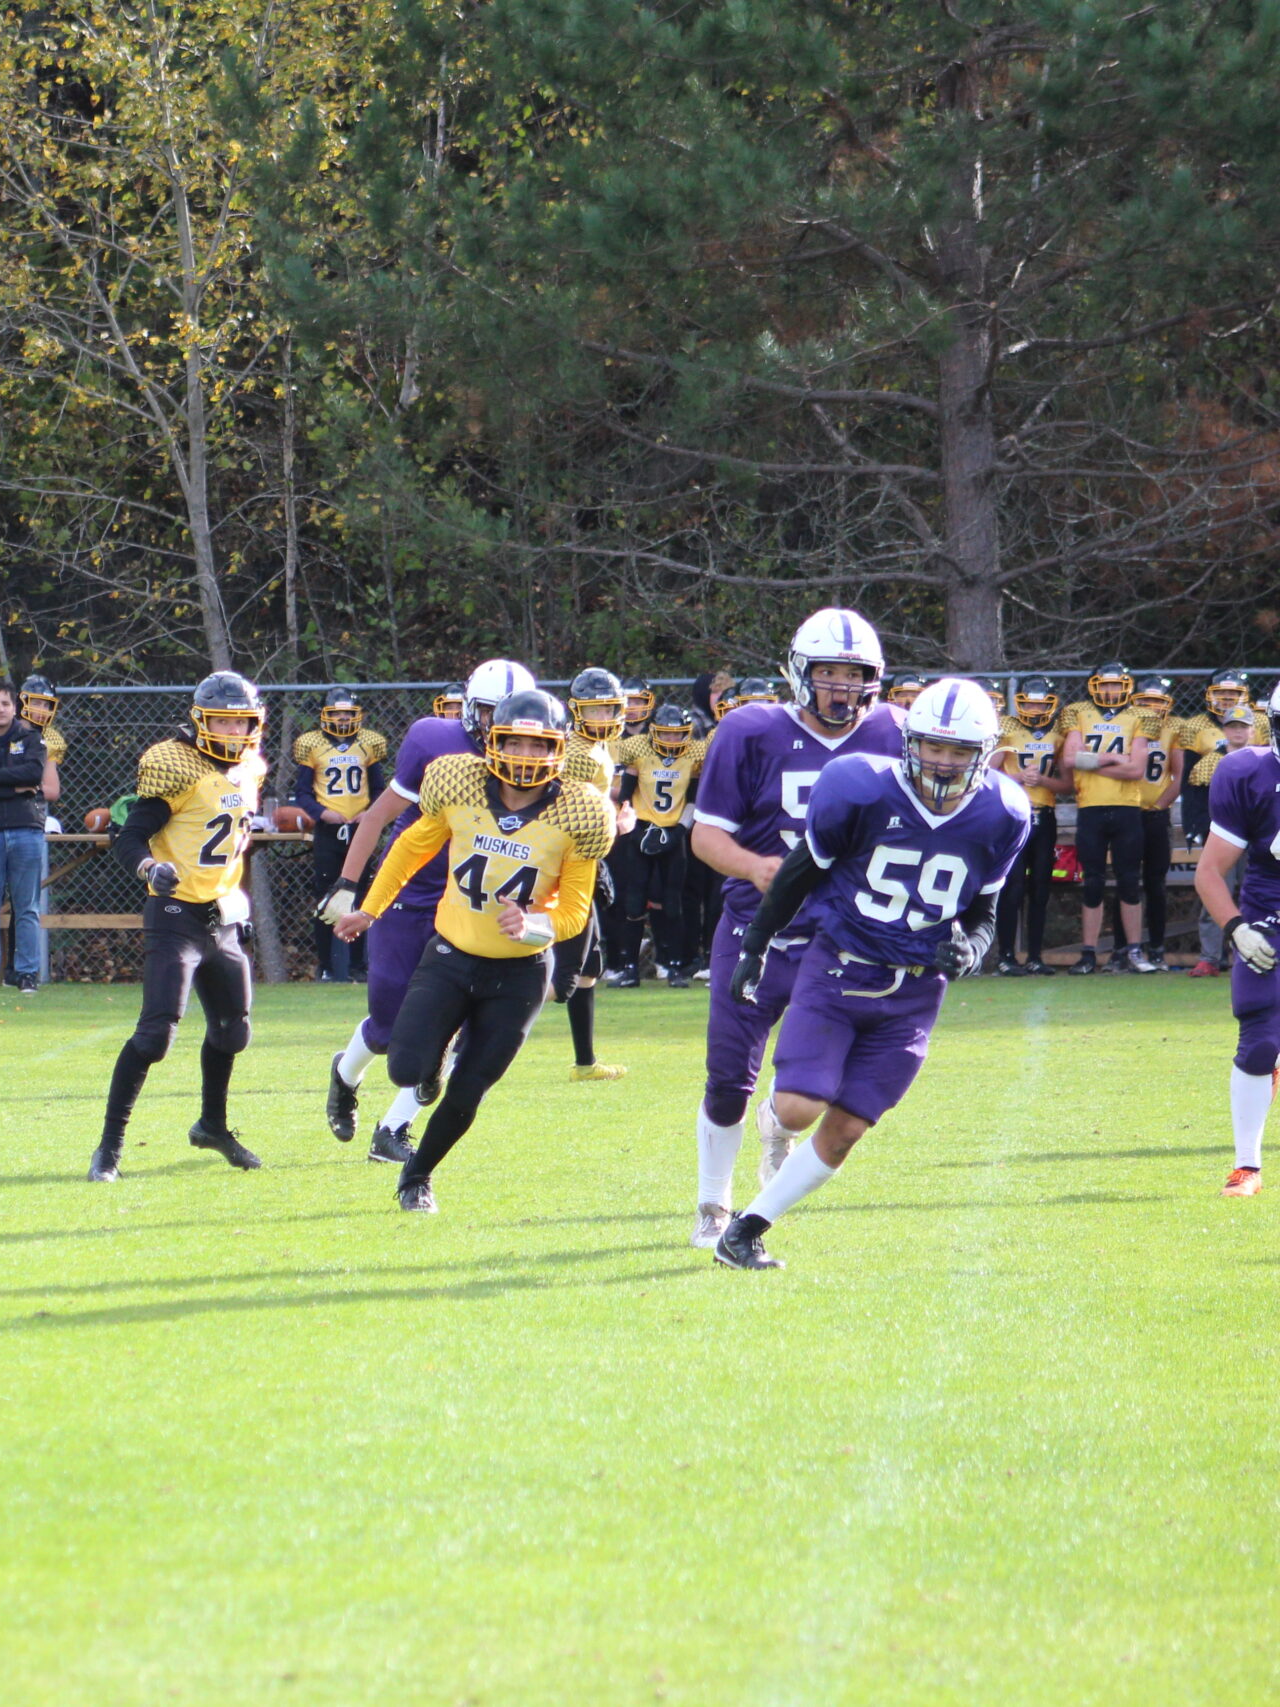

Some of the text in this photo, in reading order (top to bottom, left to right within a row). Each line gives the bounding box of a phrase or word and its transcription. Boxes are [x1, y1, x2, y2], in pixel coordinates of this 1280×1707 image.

[931, 726, 956, 736] Riddell
[329, 756, 359, 766] MUSKIES
[324, 765, 363, 796] 20
[653, 780, 674, 814] 5
[473, 834, 531, 861] MUSKIES
[452, 853, 539, 914] 44
[854, 844, 969, 932] 59
